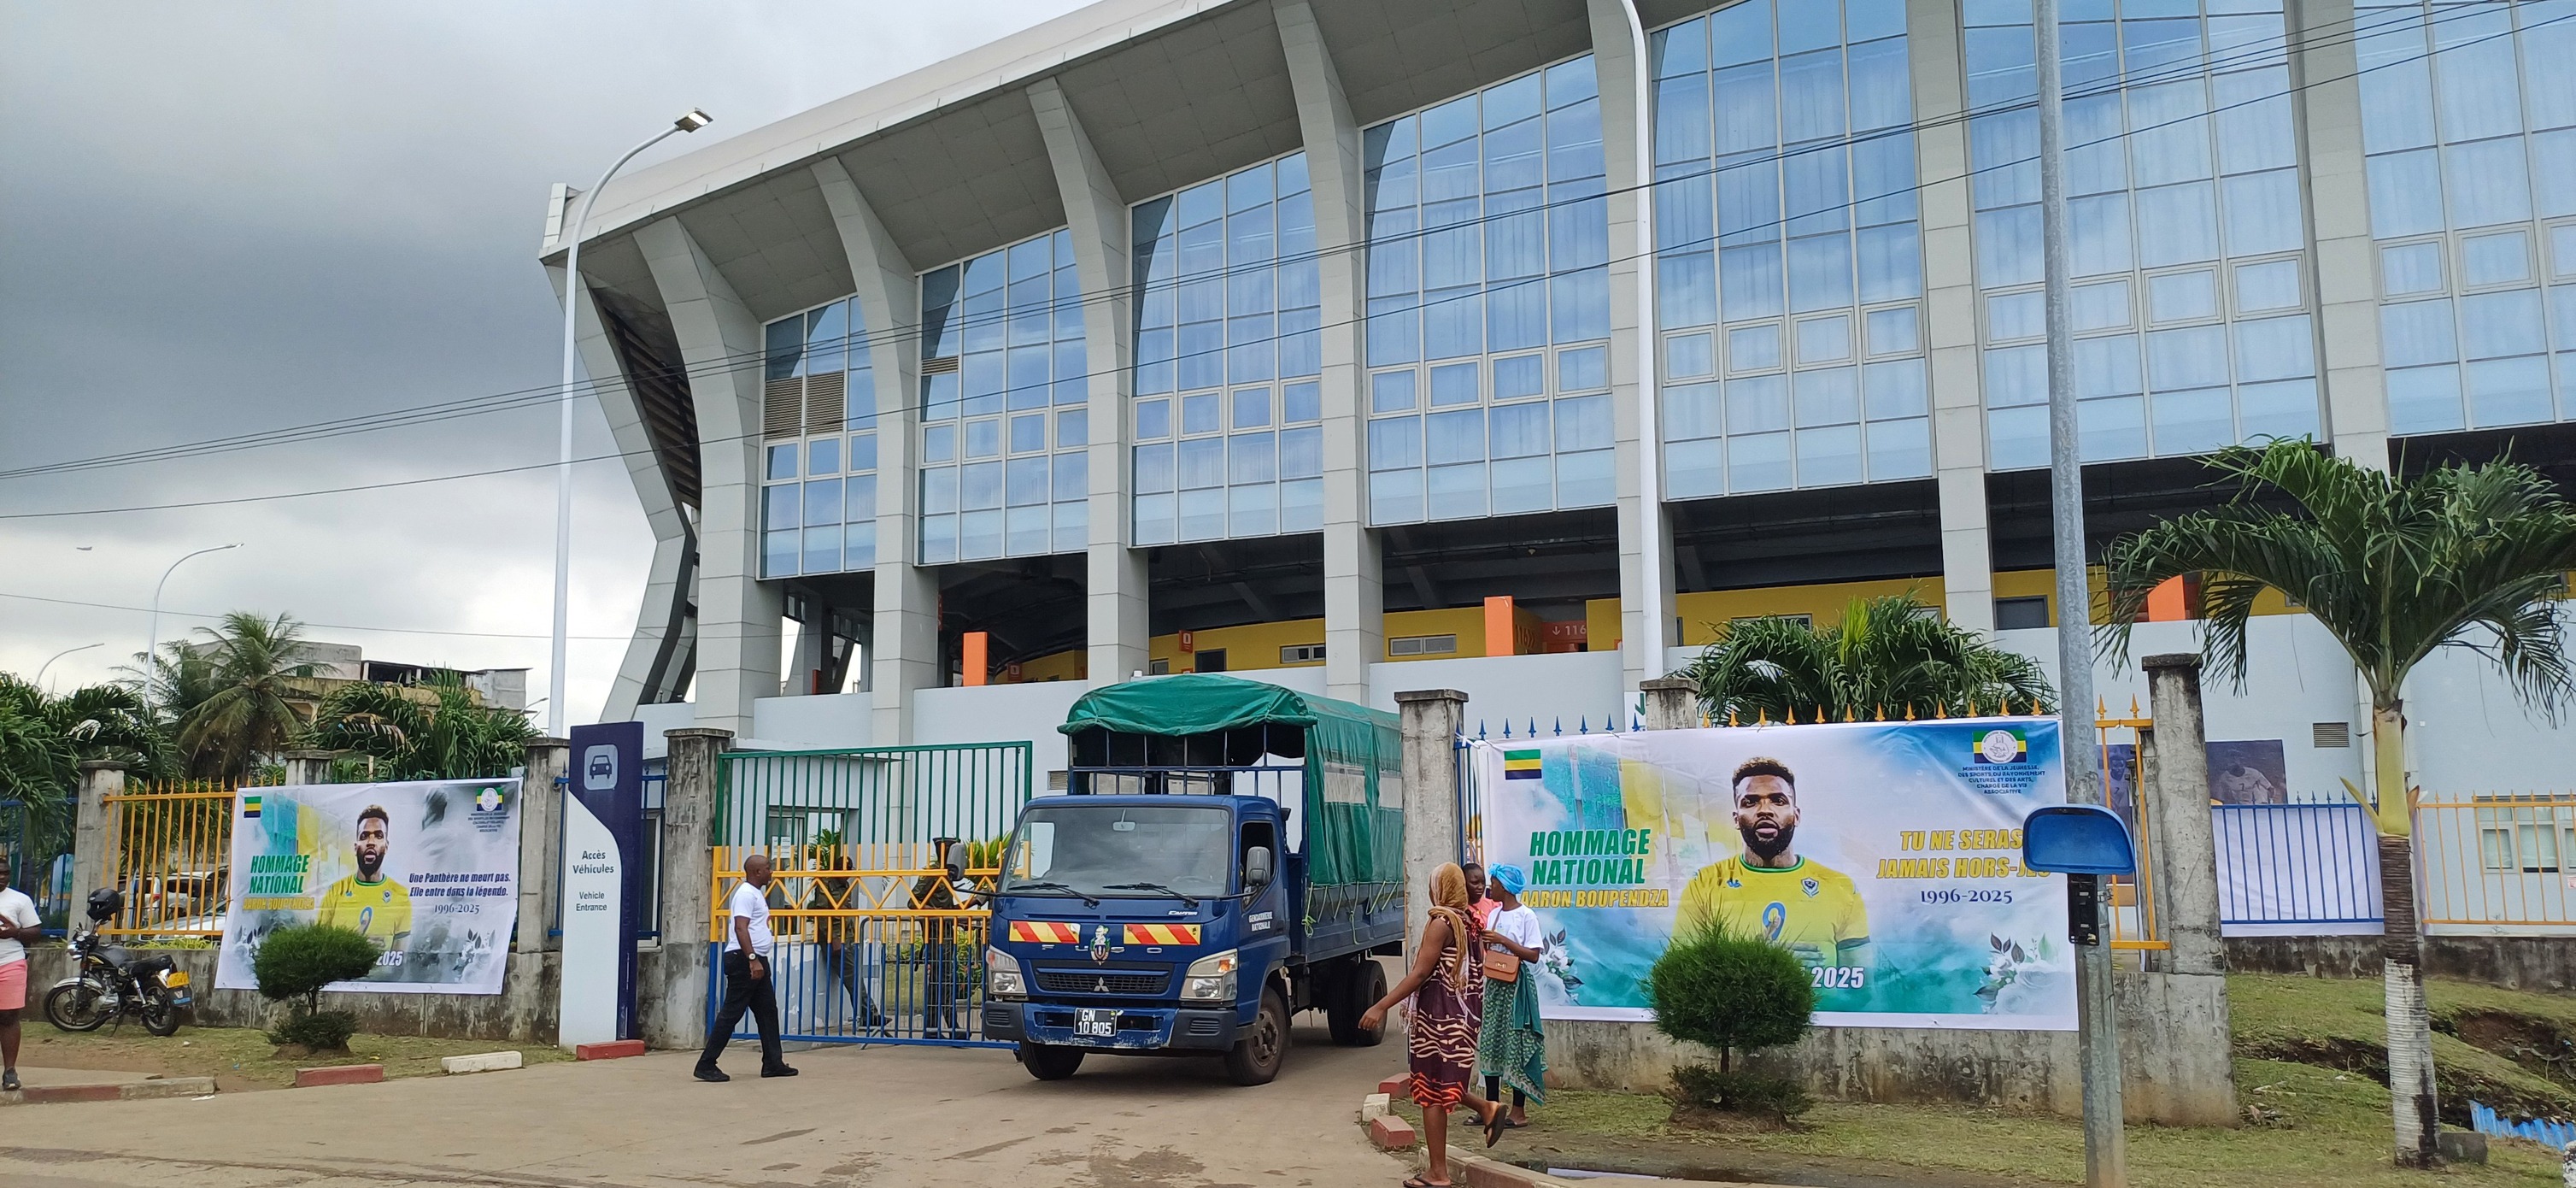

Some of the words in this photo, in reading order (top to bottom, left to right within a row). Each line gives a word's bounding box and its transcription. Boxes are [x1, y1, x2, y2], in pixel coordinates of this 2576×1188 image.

[1565, 625, 1587, 636] 116
[1529, 829, 1651, 856] HOMMAGE
[1900, 830, 1926, 851] TU
[1929, 830, 1955, 850] NE
[1958, 828, 2023, 850] SERAS
[582, 850, 606, 860] Accès
[250, 855, 310, 873] HOMMAGE
[572, 863, 614, 873] Véhicules
[1531, 858, 1646, 885] NATIONAL
[1876, 857, 1950, 879] JAMAIS
[249, 875, 304, 894] NATIONAL
[409, 873, 424, 883] Une
[424, 872, 459, 883] Panthère
[460, 873, 470, 882] ne
[470, 873, 494, 882] meurt
[495, 873, 511, 883] pas.
[409, 886, 424, 897] Elle
[425, 887, 445, 897] entre
[446, 886, 465, 897] dans
[466, 886, 474, 897] la
[475, 885, 508, 897] légende.
[1920, 889, 2013, 904] 1996-2025
[1521, 890, 1572, 909] AARON
[1576, 889, 1669, 908] BOUPENDZA
[435, 903, 479, 915] 1996-2025
[1811, 966, 1865, 989] 2025
[1082, 1009, 1095, 1022] GN
[1078, 1021, 1090, 1034] 10
[1091, 1022, 1112, 1035] 805
